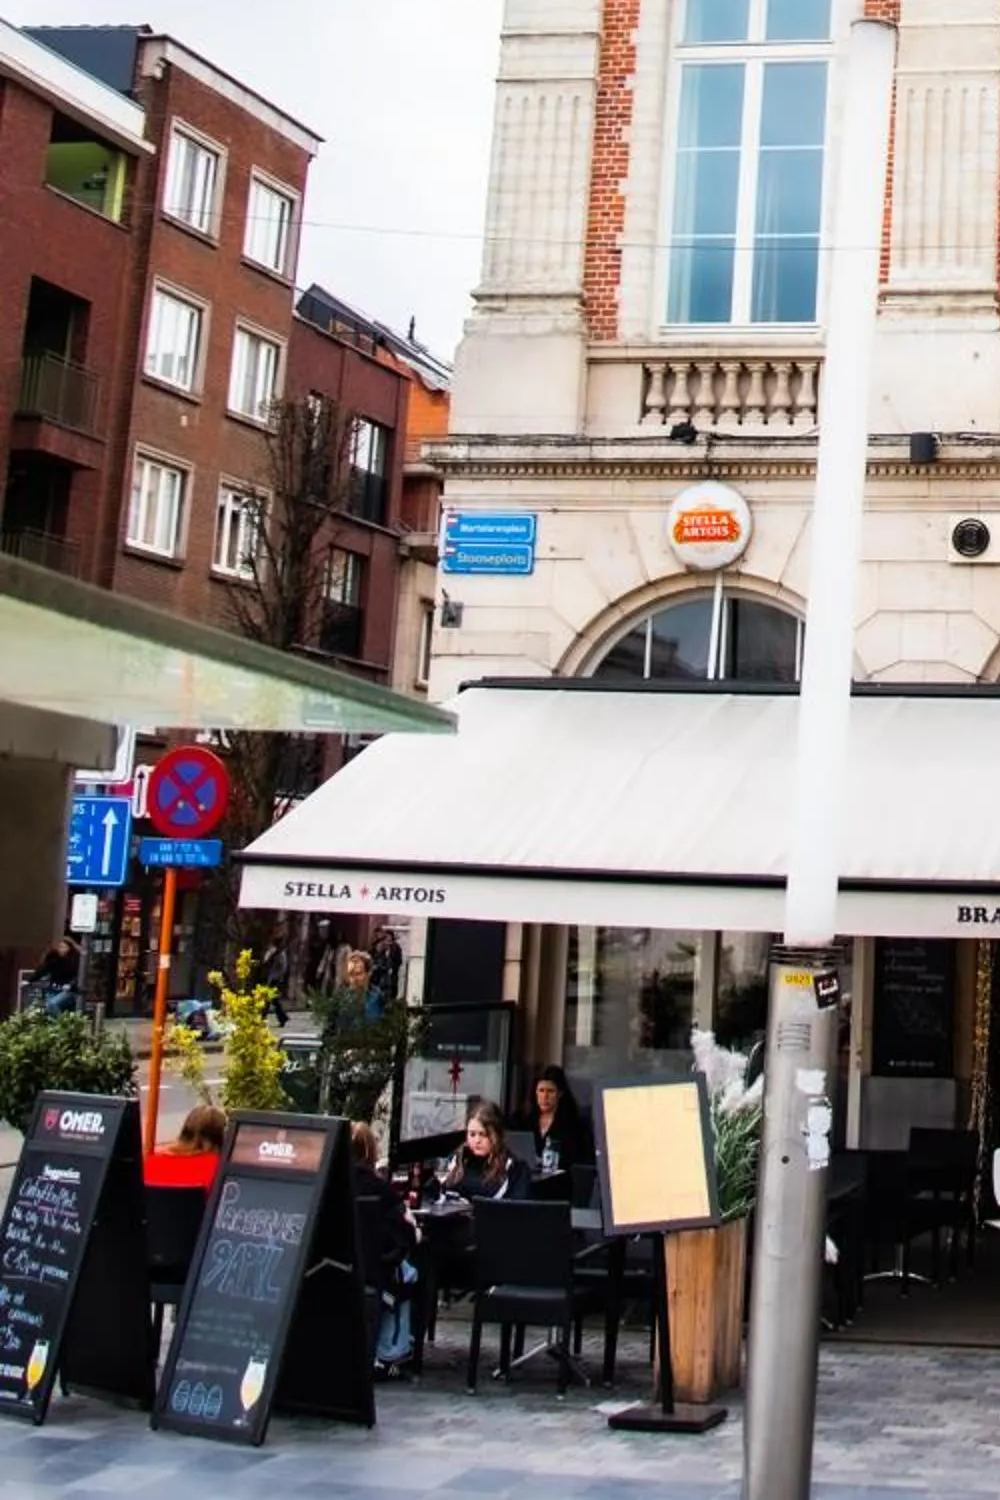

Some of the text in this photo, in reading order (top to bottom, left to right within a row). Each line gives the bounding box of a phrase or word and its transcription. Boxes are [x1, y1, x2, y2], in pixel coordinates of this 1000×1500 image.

[683, 514, 729, 525] STELLA
[682, 526, 729, 537] ARTOIS
[283, 881, 446, 903] STELLA ARTOIS
